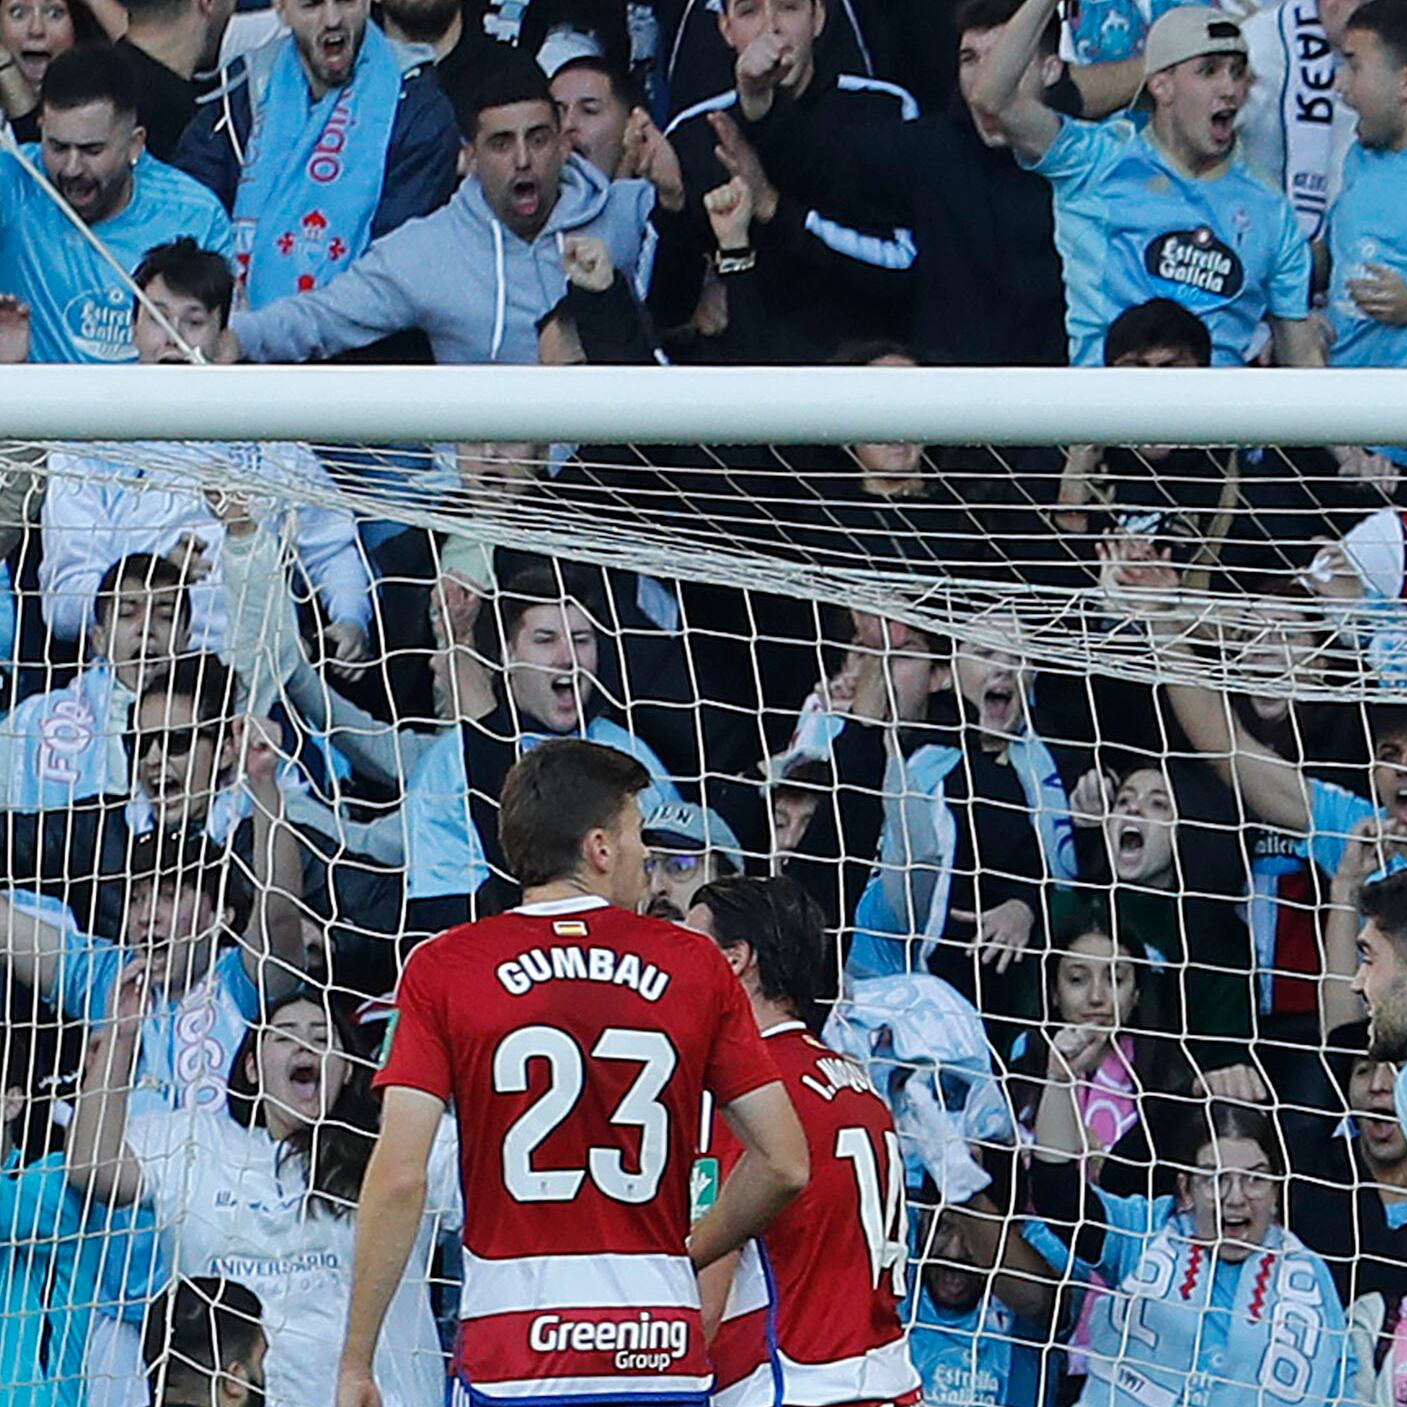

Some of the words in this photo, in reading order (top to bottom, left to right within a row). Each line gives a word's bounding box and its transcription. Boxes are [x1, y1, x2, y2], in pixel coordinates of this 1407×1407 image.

[1159, 259, 1224, 293] Galicia
[1161, 236, 1232, 275] Estrella
[496, 946, 670, 1002] GUMBAU
[492, 1025, 679, 1204] 23
[835, 1126, 910, 1297] 14
[530, 1311, 687, 1358] Greening
[615, 1351, 670, 1371] Group
